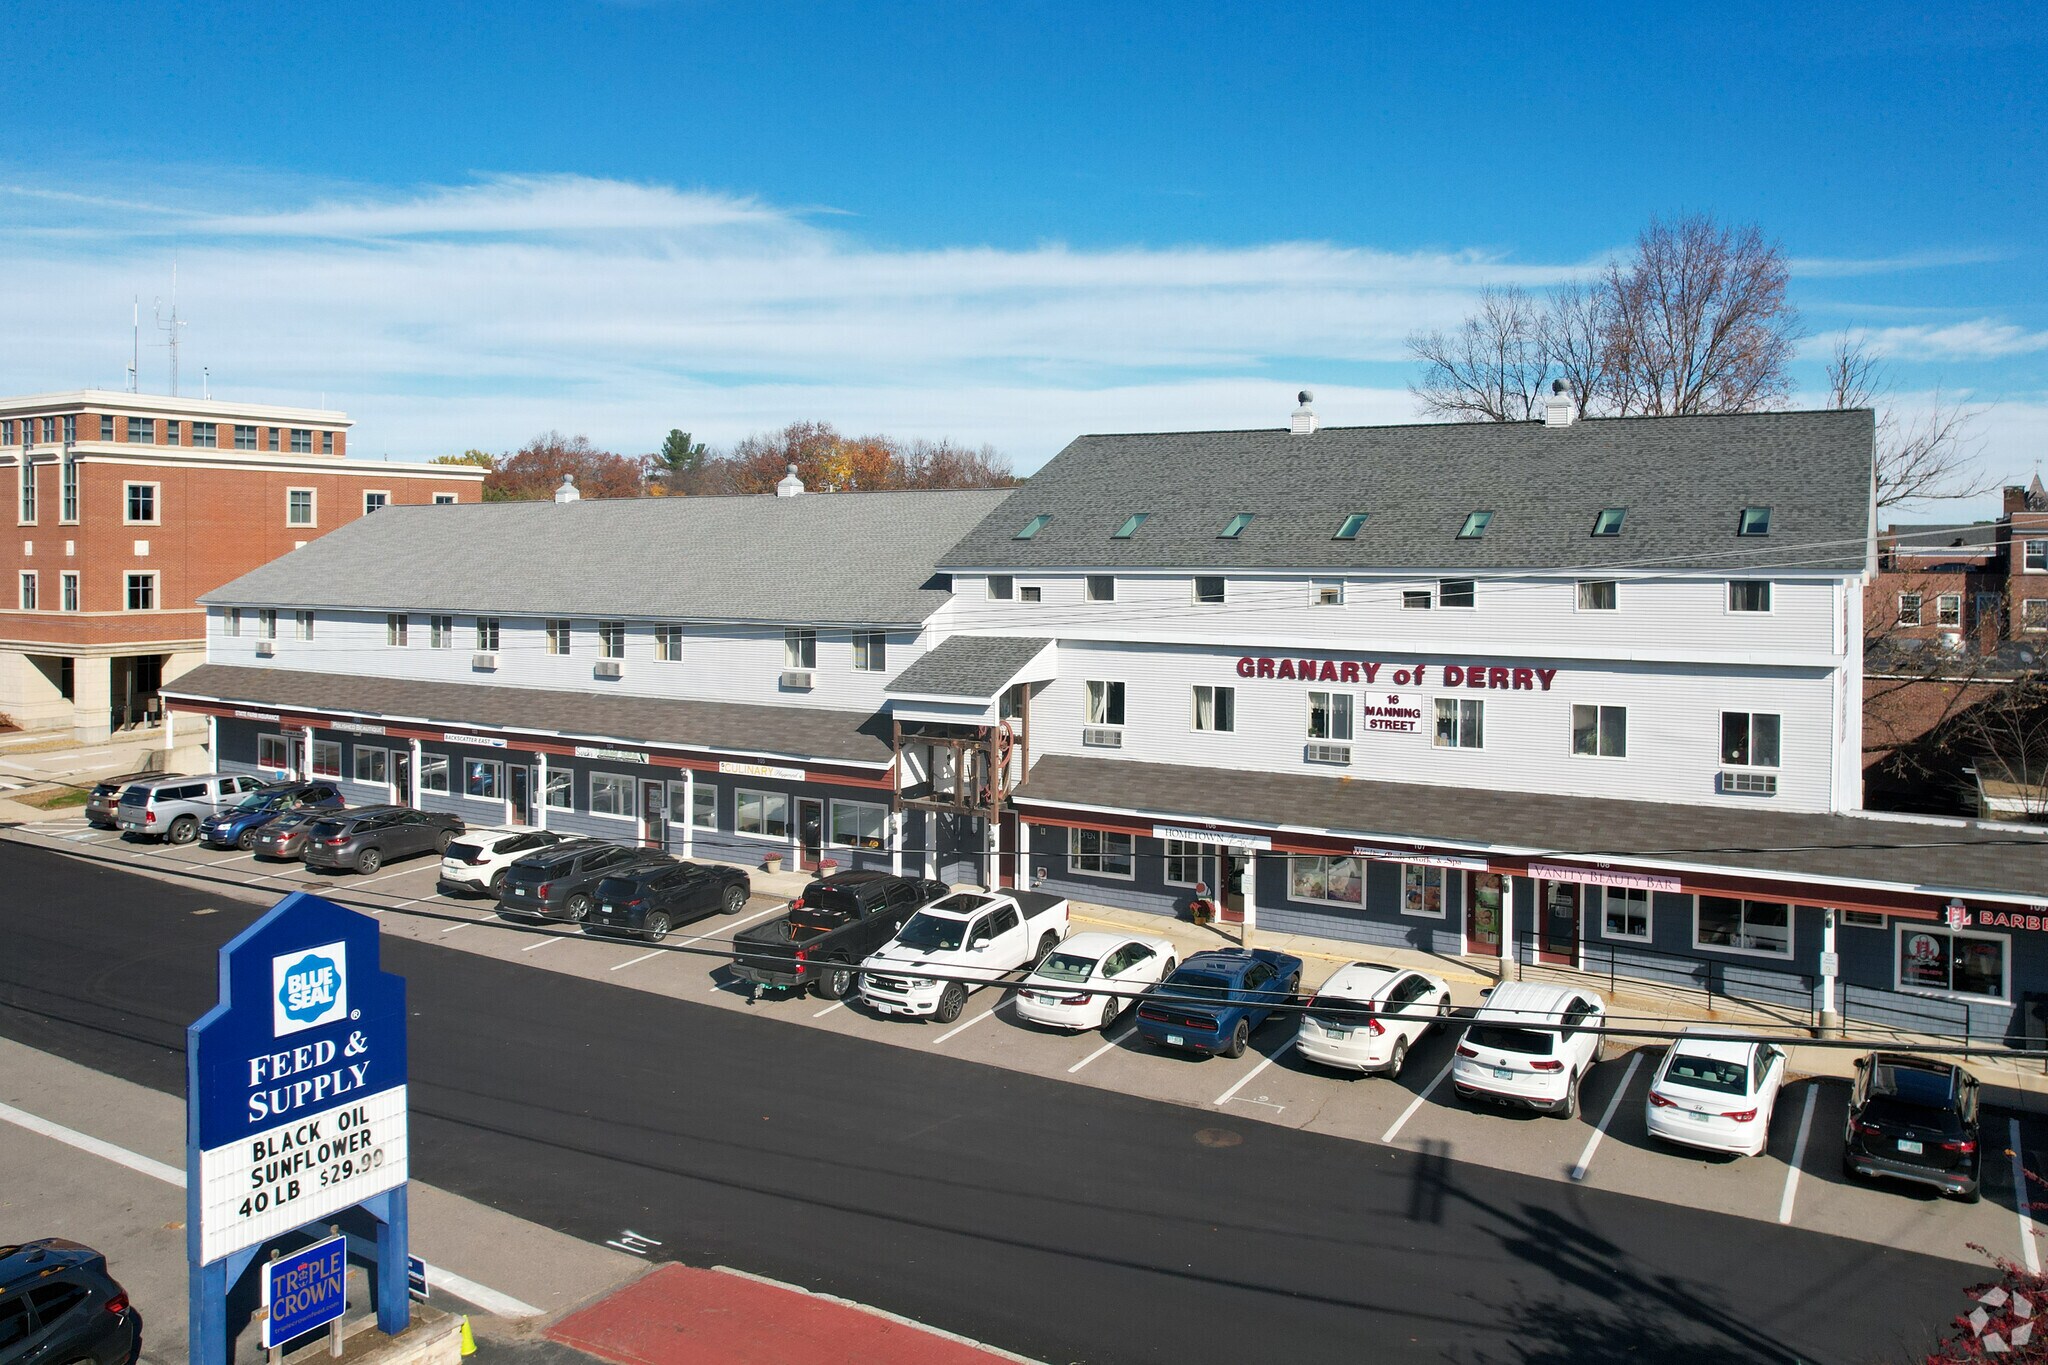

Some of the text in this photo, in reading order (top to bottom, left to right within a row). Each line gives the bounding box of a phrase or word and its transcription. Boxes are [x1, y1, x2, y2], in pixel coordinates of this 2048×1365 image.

[1236, 657, 1557, 691] GRANARY of DERRY
[1365, 706, 1421, 719] MANNING
[1386, 695, 1400, 705] 16
[1369, 719, 1415, 731] STREET
[445, 735, 477, 743] BACKSCATTER
[725, 763, 774, 776] CULINARY
[1165, 828, 1224, 843] HOMETOWN
[1444, 857, 1462, 867] Spa
[1534, 866, 1674, 890] VANITY BEAUTY BAR
[288, 966, 333, 994] BLUE
[288, 986, 334, 1012] SEAL
[248, 1030, 368, 1088] FEED &
[248, 1060, 370, 1124] SUPPLY
[253, 1106, 370, 1162] BLACK OIL
[252, 1129, 372, 1189] SUNFLOWER
[320, 1148, 384, 1188] $29.99
[273, 1274, 341, 1322] CROWN
[274, 1302, 340, 1334] triplecrownfeed.com
